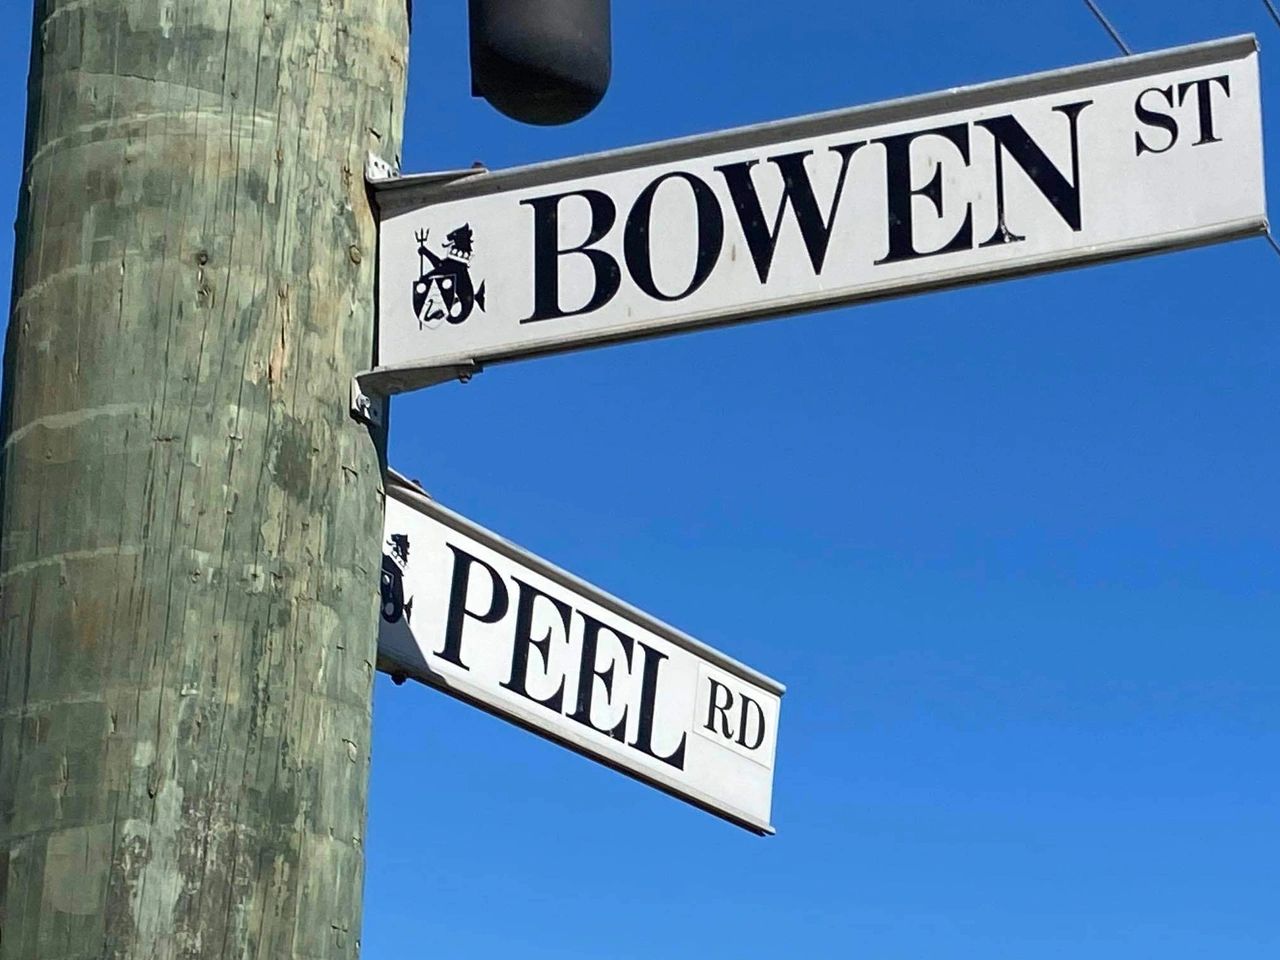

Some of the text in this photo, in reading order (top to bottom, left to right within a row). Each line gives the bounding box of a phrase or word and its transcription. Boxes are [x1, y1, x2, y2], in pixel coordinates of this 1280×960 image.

[519, 75, 1231, 325] BOWEN ST
[432, 541, 766, 772] PEEL RD
